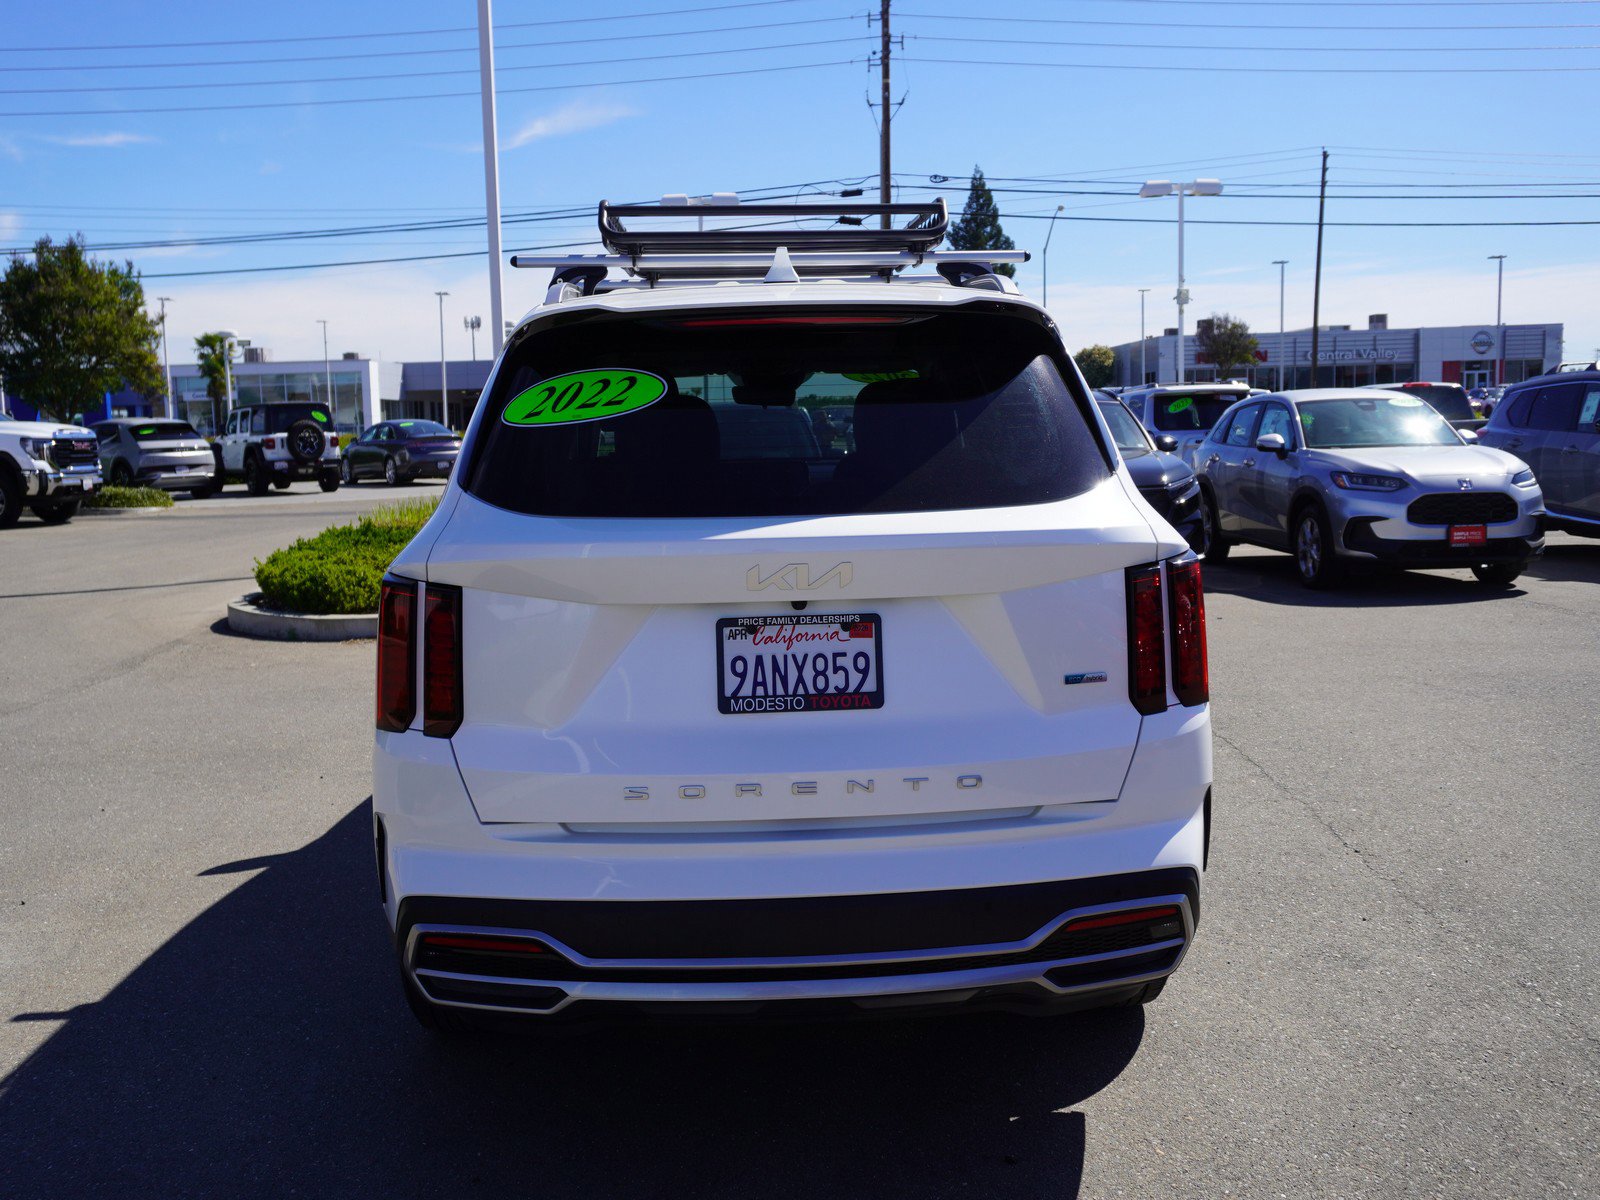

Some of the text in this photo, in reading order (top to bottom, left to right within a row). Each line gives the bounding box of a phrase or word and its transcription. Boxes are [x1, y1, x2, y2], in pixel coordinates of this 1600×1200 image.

[1360, 347, 1400, 361] Valley
[520, 375, 639, 420] 2022
[738, 614, 861, 626] PRICE FAMILY DEALERSHIPS
[727, 625, 851, 651] APR California
[730, 651, 871, 697] 9ANX859
[730, 694, 872, 712] MODESTO TOYOTA
[623, 774, 983, 801] SORENTO
